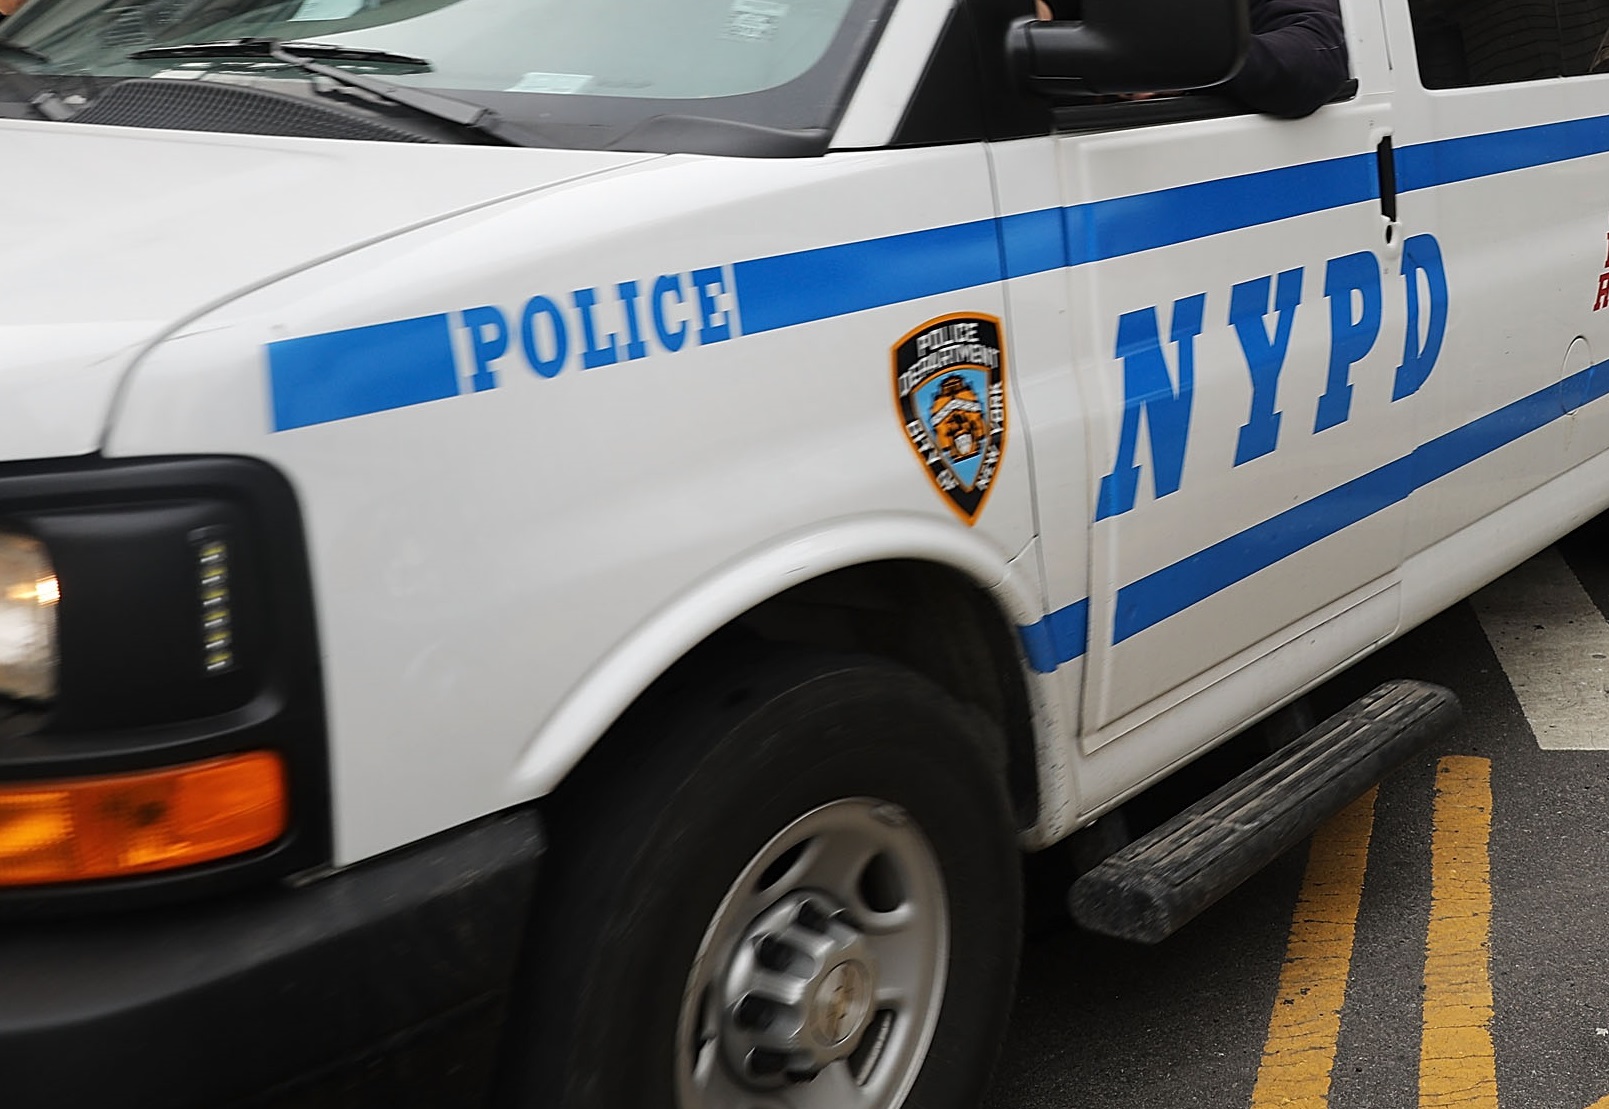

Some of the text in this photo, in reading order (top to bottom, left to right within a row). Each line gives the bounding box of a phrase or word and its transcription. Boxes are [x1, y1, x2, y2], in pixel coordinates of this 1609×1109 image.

[460, 265, 732, 393] POLICE
[916, 322, 979, 358] POLICE
[898, 343, 1000, 398] DEPARTMENT
[1095, 233, 1449, 522] NYPD
[989, 382, 1004, 435] YORK
